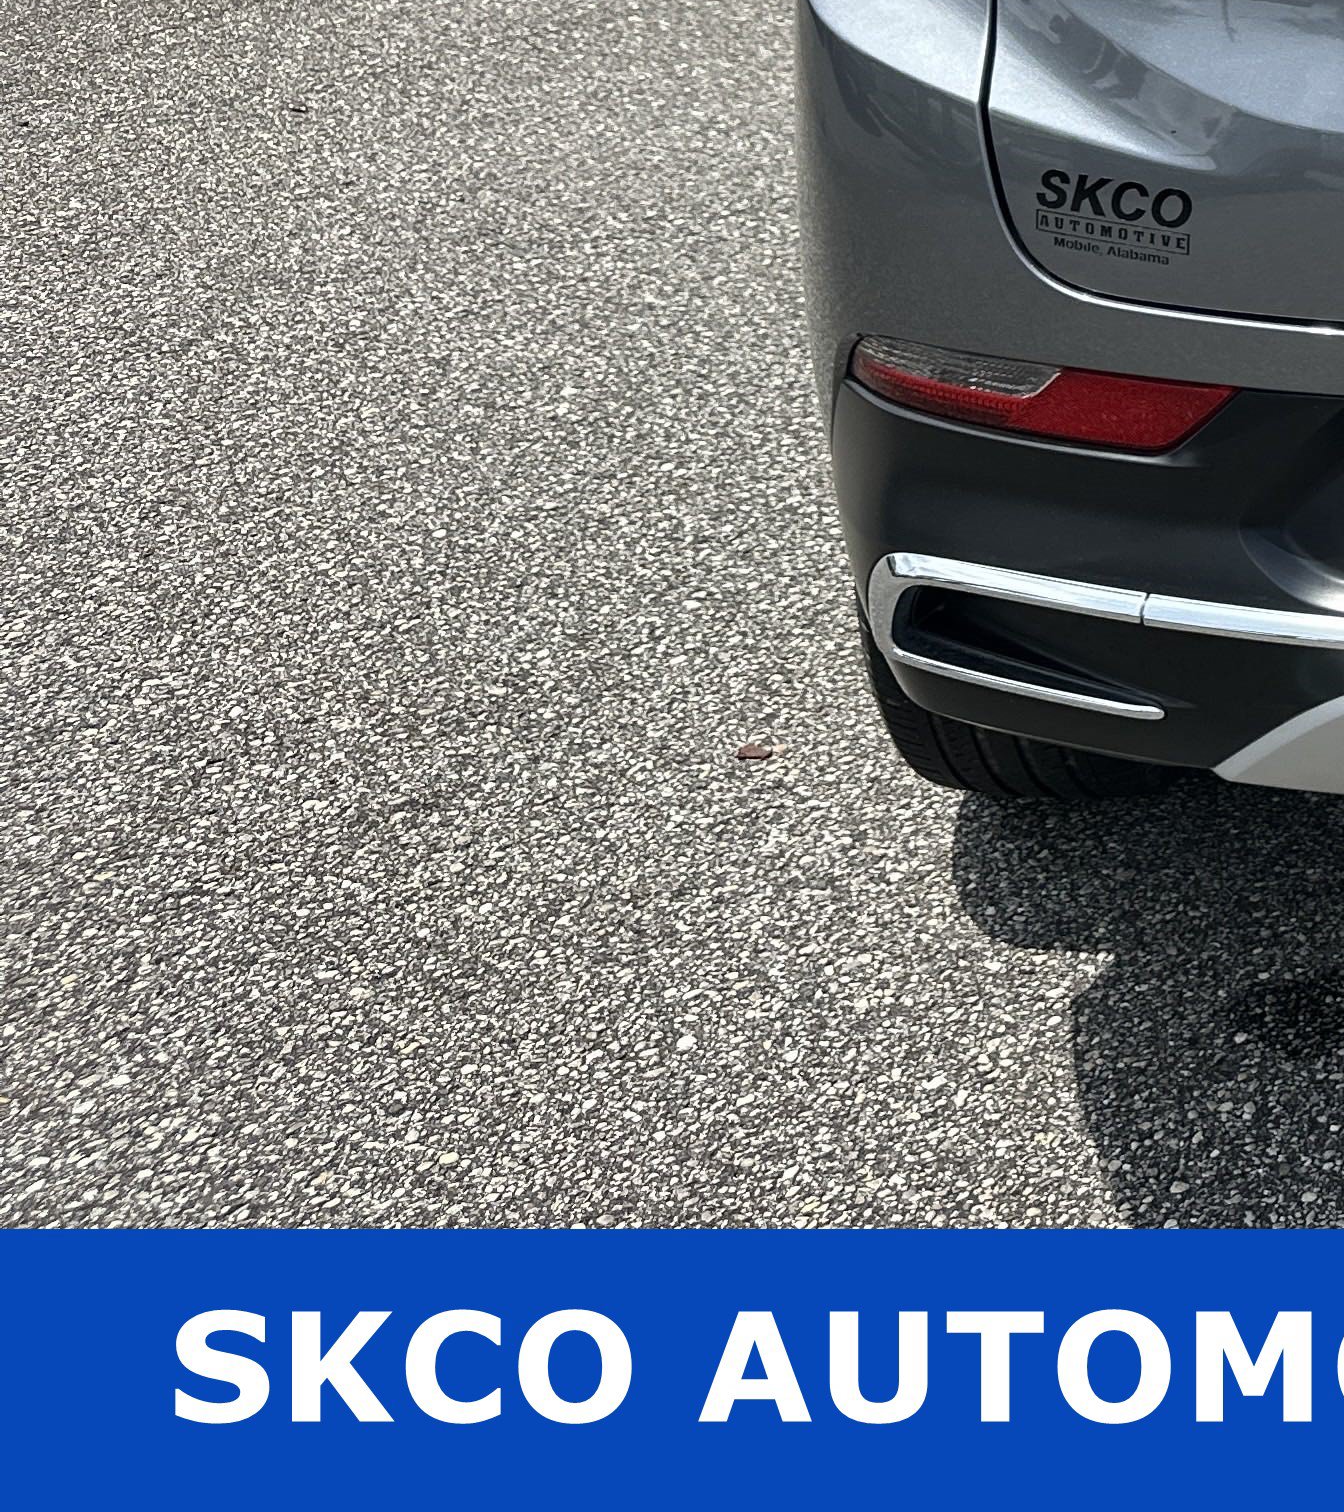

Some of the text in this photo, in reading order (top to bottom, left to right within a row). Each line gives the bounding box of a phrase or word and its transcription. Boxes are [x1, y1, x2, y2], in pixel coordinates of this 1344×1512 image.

[1036, 169, 1193, 228] SKCO
[1039, 214, 1186, 250] AUTOMOTIVE
[1053, 236, 1169, 265] Mobile, Alabama
